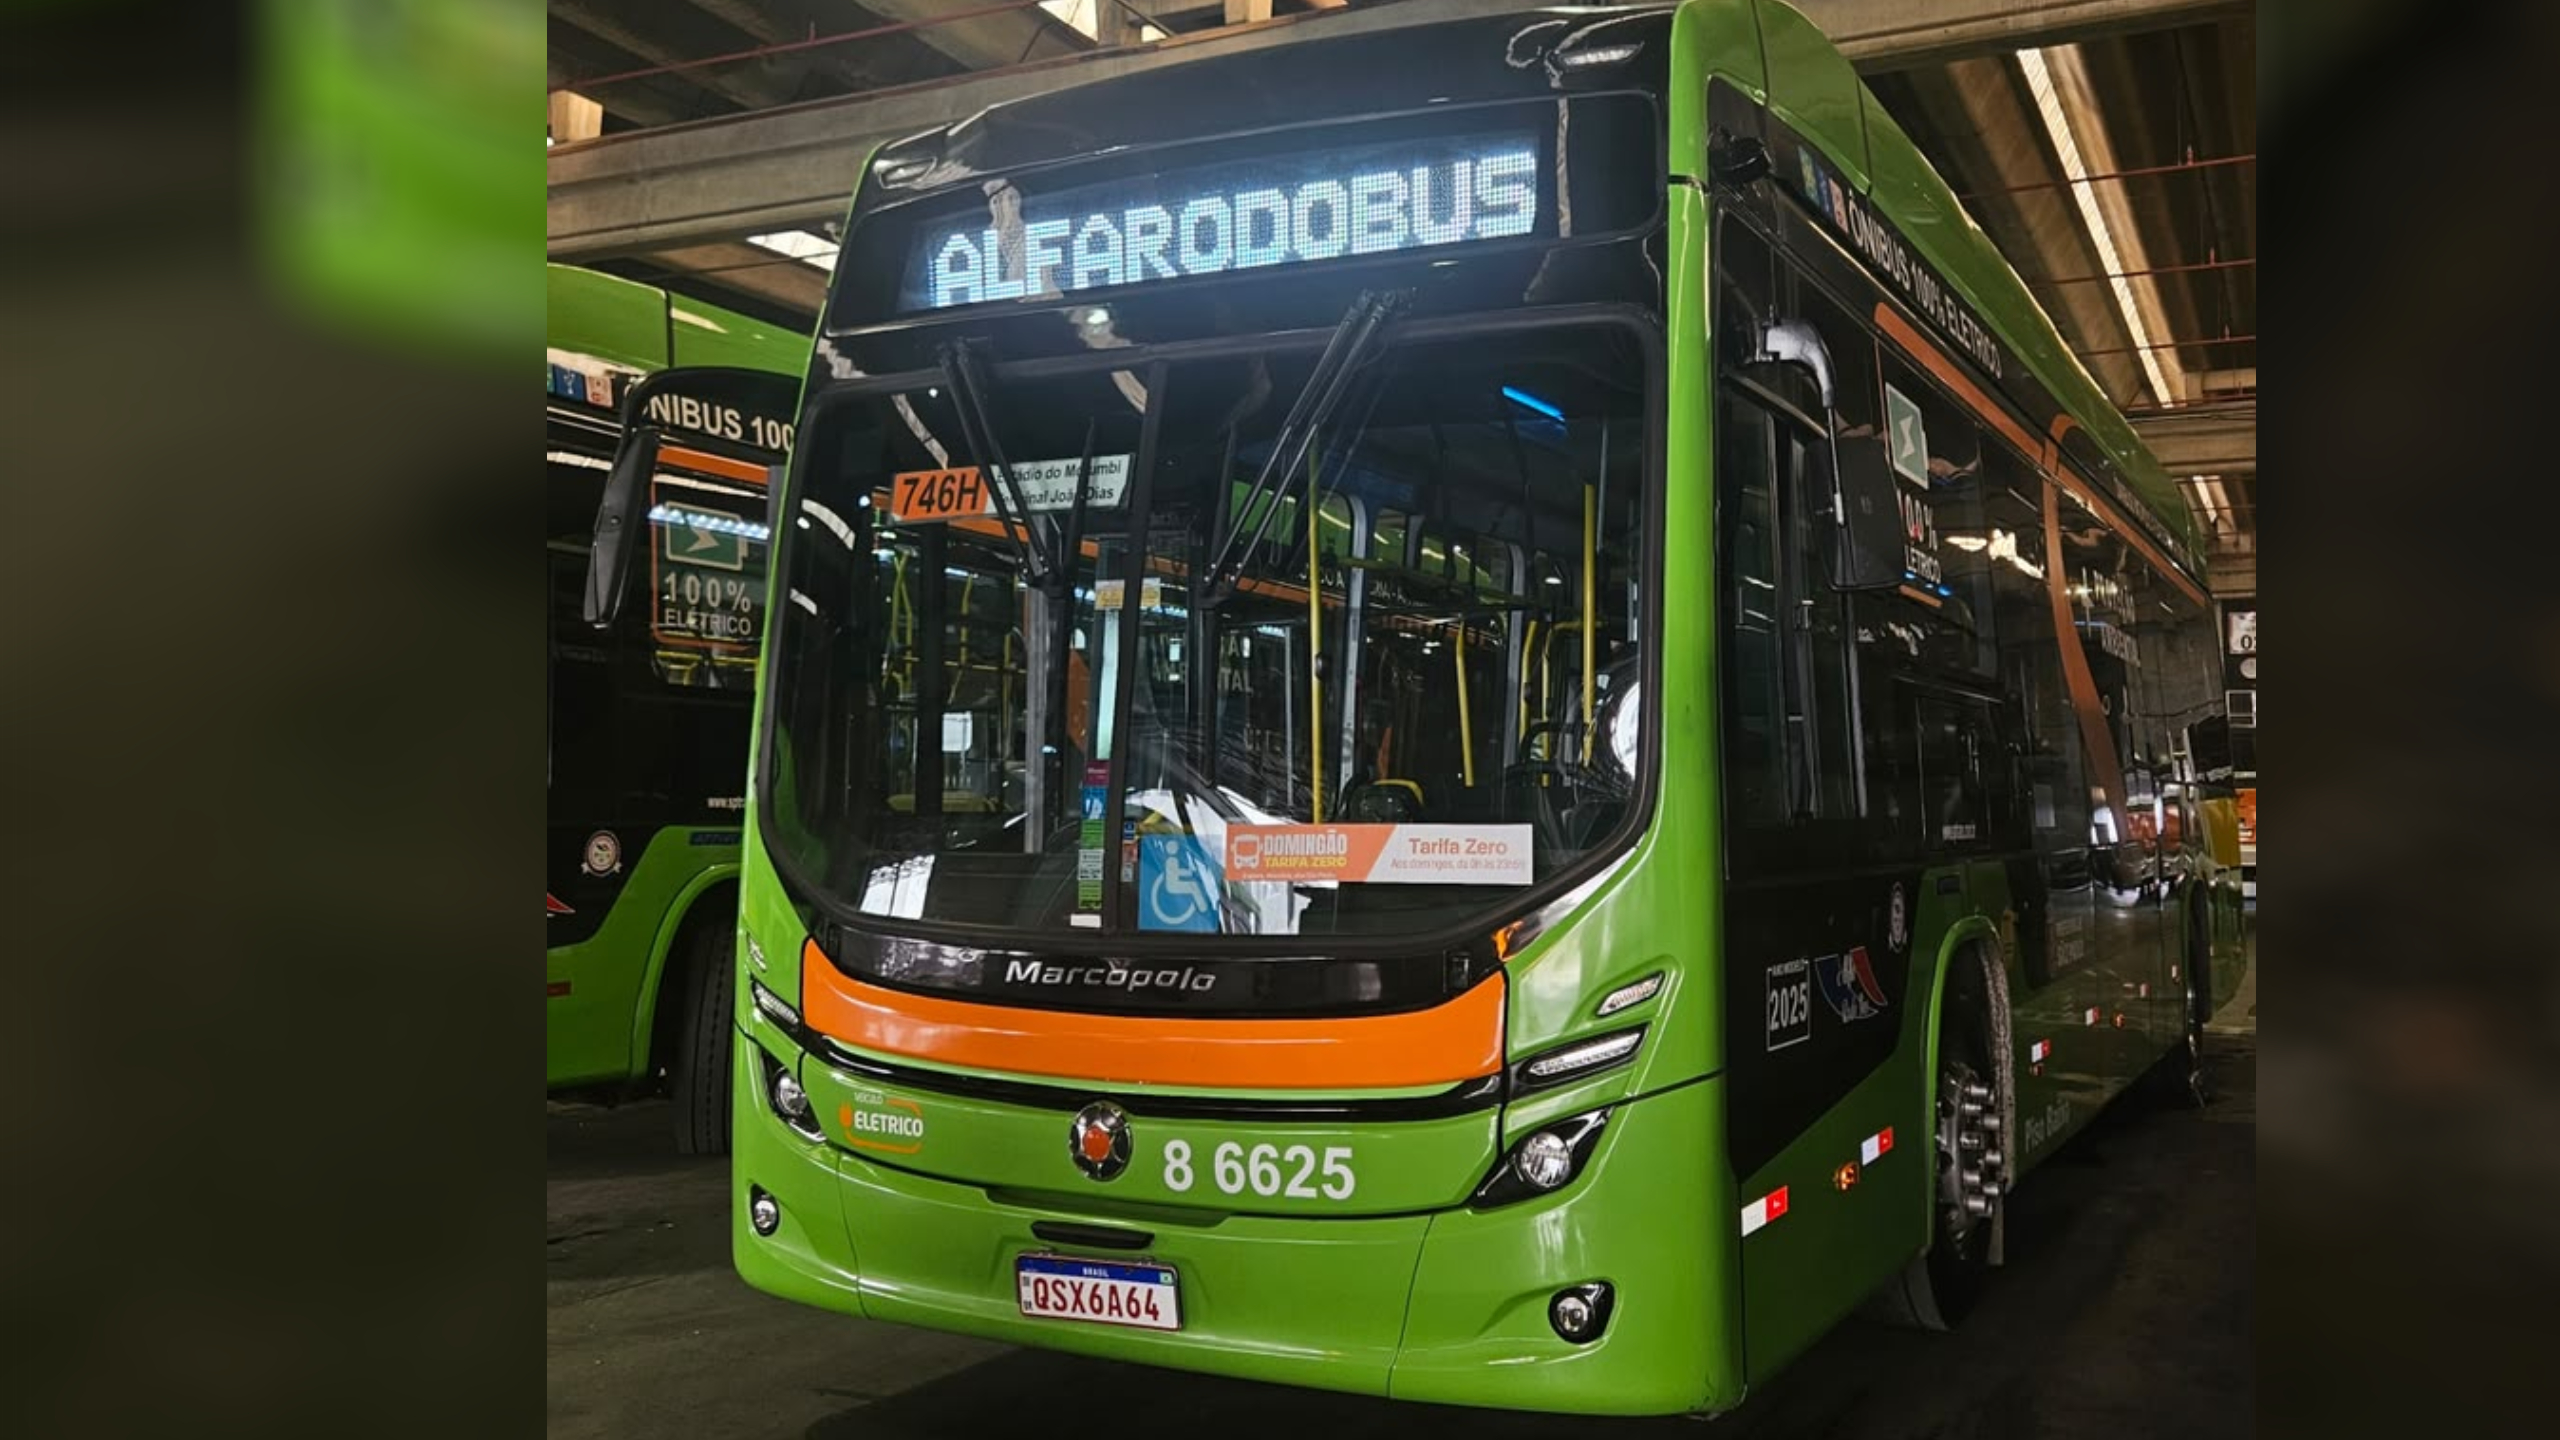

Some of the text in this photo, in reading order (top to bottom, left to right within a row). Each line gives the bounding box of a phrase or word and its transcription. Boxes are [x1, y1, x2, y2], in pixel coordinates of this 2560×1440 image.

[931, 151, 1538, 307] ALFARODOBUS
[642, 394, 742, 440] NIBUS
[903, 473, 980, 516] 746H
[1086, 486, 1114, 501] Dias
[663, 571, 751, 613] 100%
[1264, 830, 1347, 856] DOMINGÃO
[1264, 856, 1348, 869] TARIFA ZERO
[1408, 838, 1508, 855] Tarifa Zero
[1004, 960, 1216, 992] Marcopolo
[1769, 982, 1809, 1031] 2025
[1163, 1139, 1356, 1200] 8 6625
[1082, 1266, 1110, 1278] BRASIL
[1033, 1277, 1160, 1322] QSX6A64
